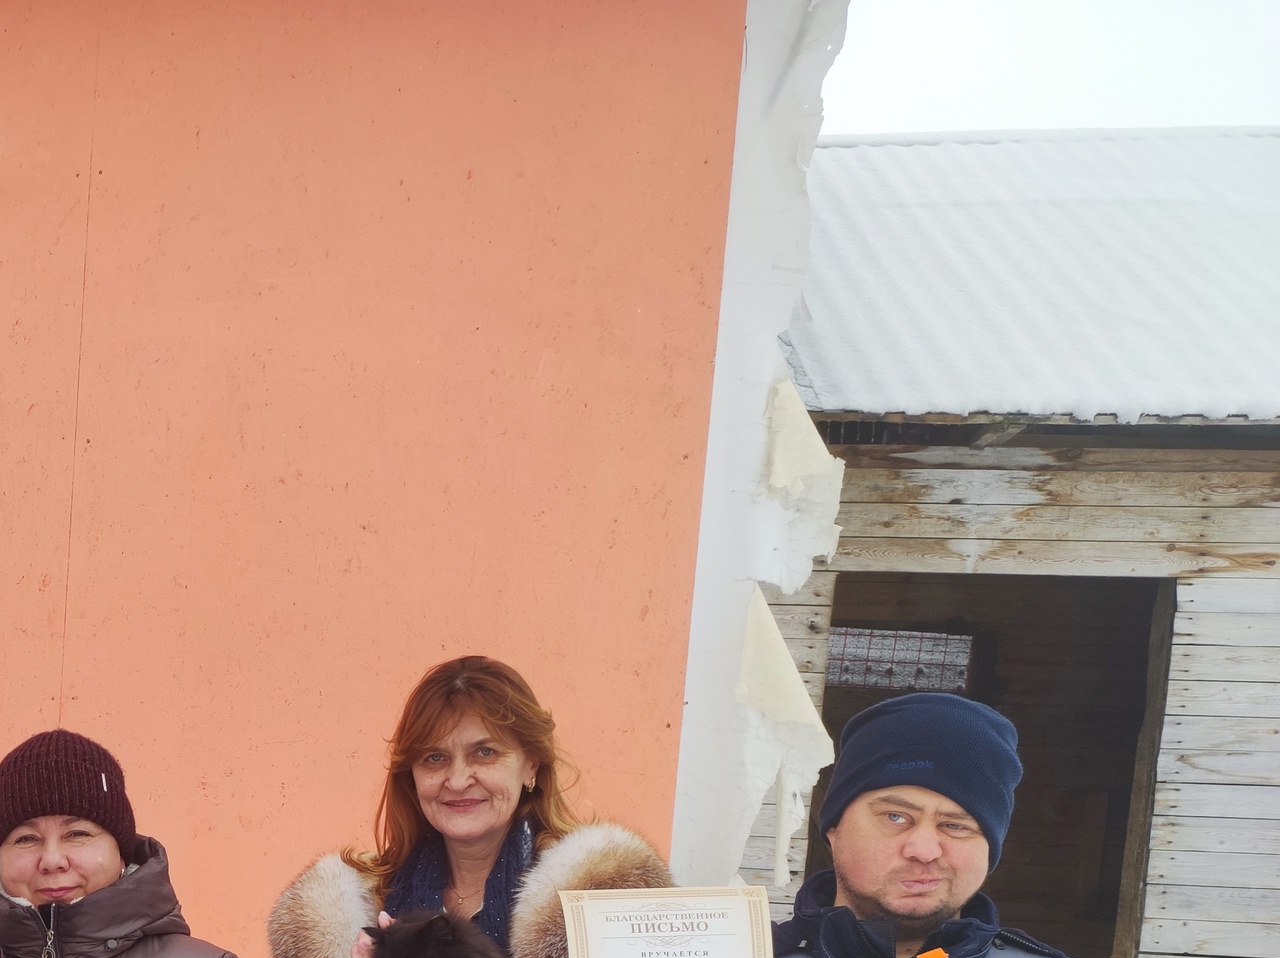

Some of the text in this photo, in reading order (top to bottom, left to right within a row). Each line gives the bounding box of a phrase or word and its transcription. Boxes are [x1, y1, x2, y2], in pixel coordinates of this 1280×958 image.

[604, 911, 729, 922] БЛАГОДАРСТВЕННОЕ
[630, 920, 709, 934] ПИСЬМО
[641, 950, 710, 958] ВРУЧАЕТСЯ
